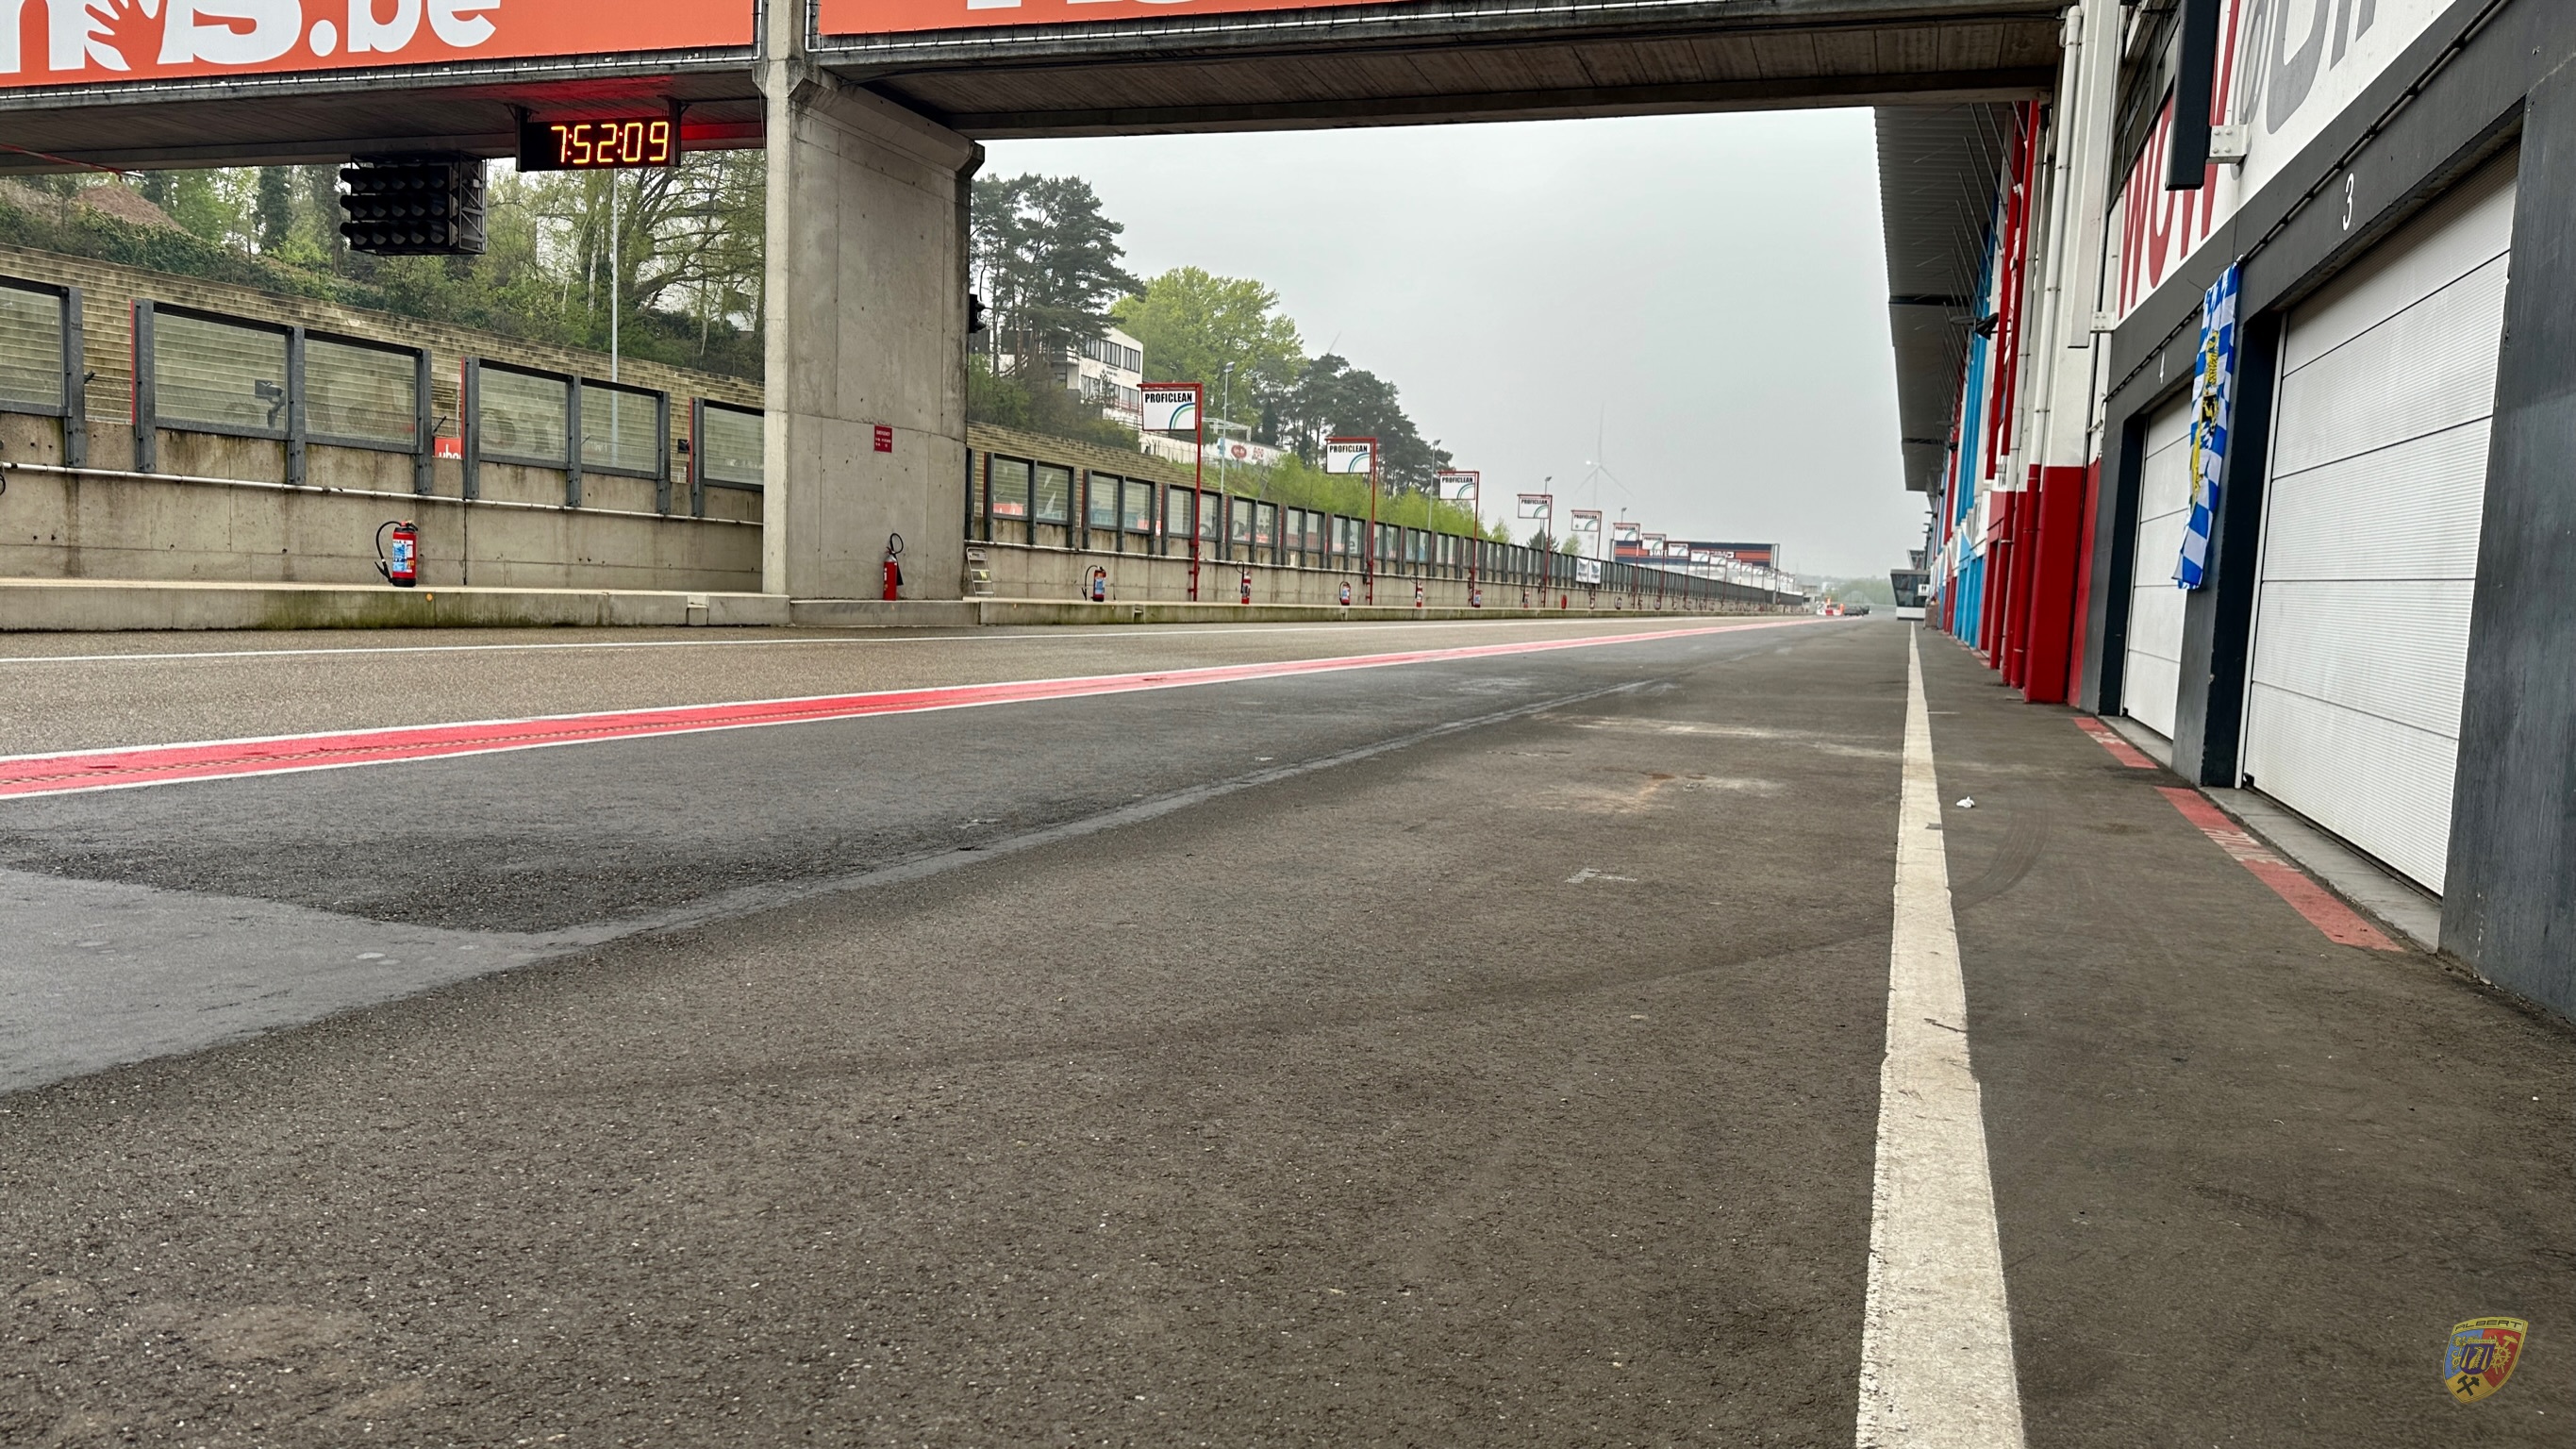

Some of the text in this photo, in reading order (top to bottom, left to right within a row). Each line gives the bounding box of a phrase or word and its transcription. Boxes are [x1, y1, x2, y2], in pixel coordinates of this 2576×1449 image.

[550, 121, 670, 164] 7:52:09
[2342, 172, 2354, 231] 3
[1144, 392, 1193, 404] PROFICLEAN
[1329, 444, 1368, 453] PROFICLEAN
